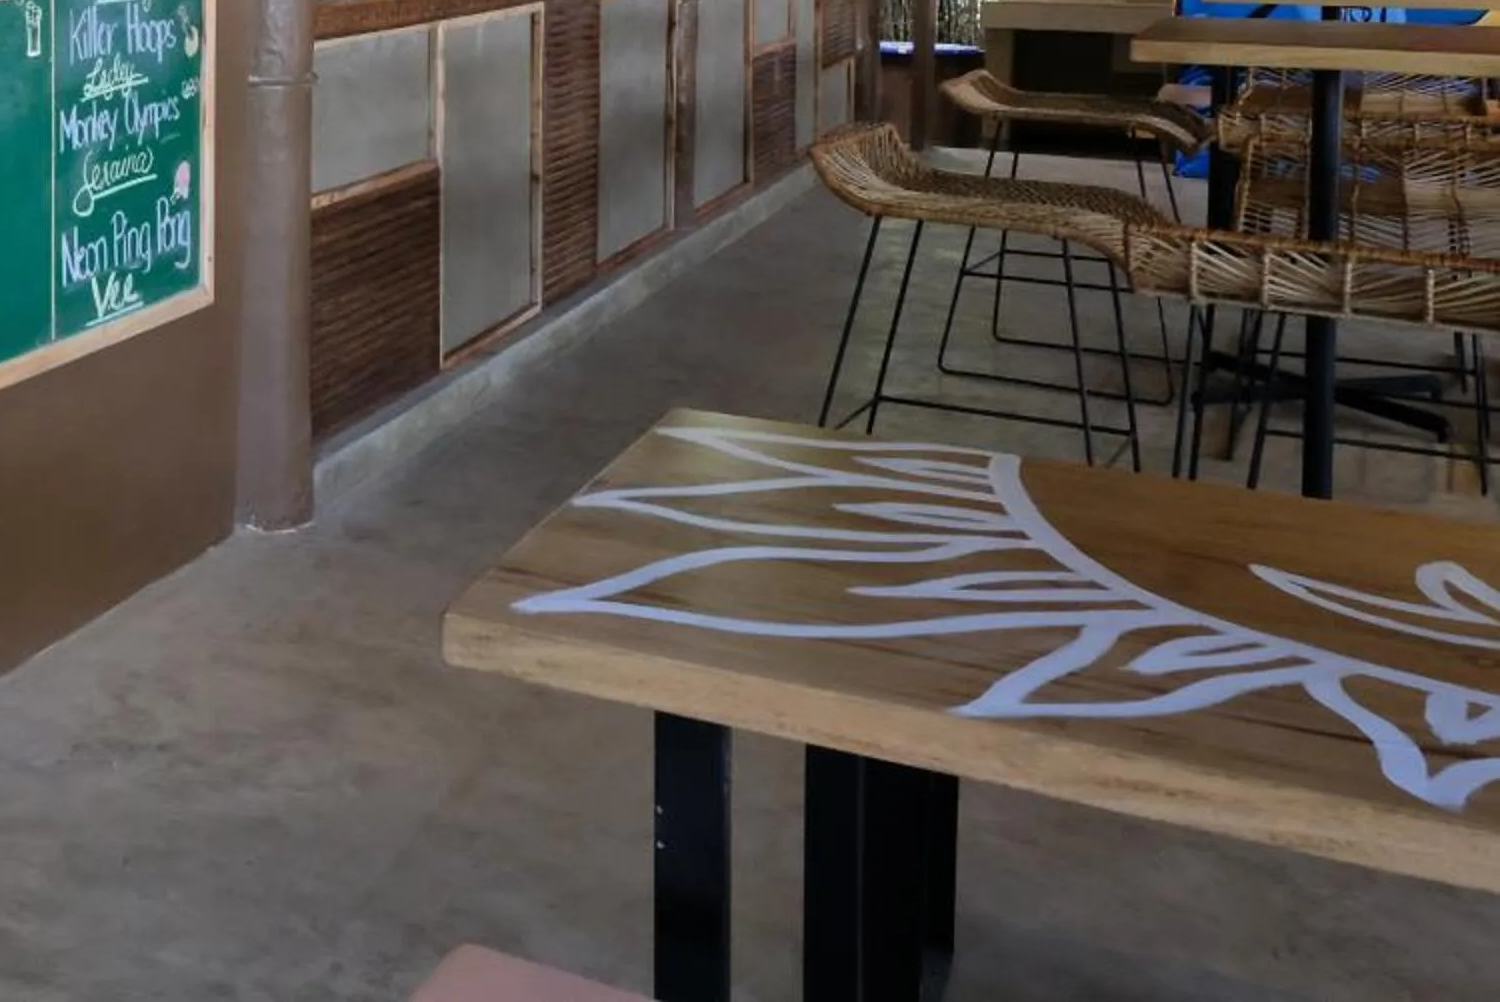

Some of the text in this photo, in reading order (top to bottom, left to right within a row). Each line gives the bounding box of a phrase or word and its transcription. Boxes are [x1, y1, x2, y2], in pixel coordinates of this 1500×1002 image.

[69, 2, 177, 65] Killer Hoops
[60, 90, 181, 154] Monkey Olympics
[62, 197, 191, 287] Neon Ping Pong
